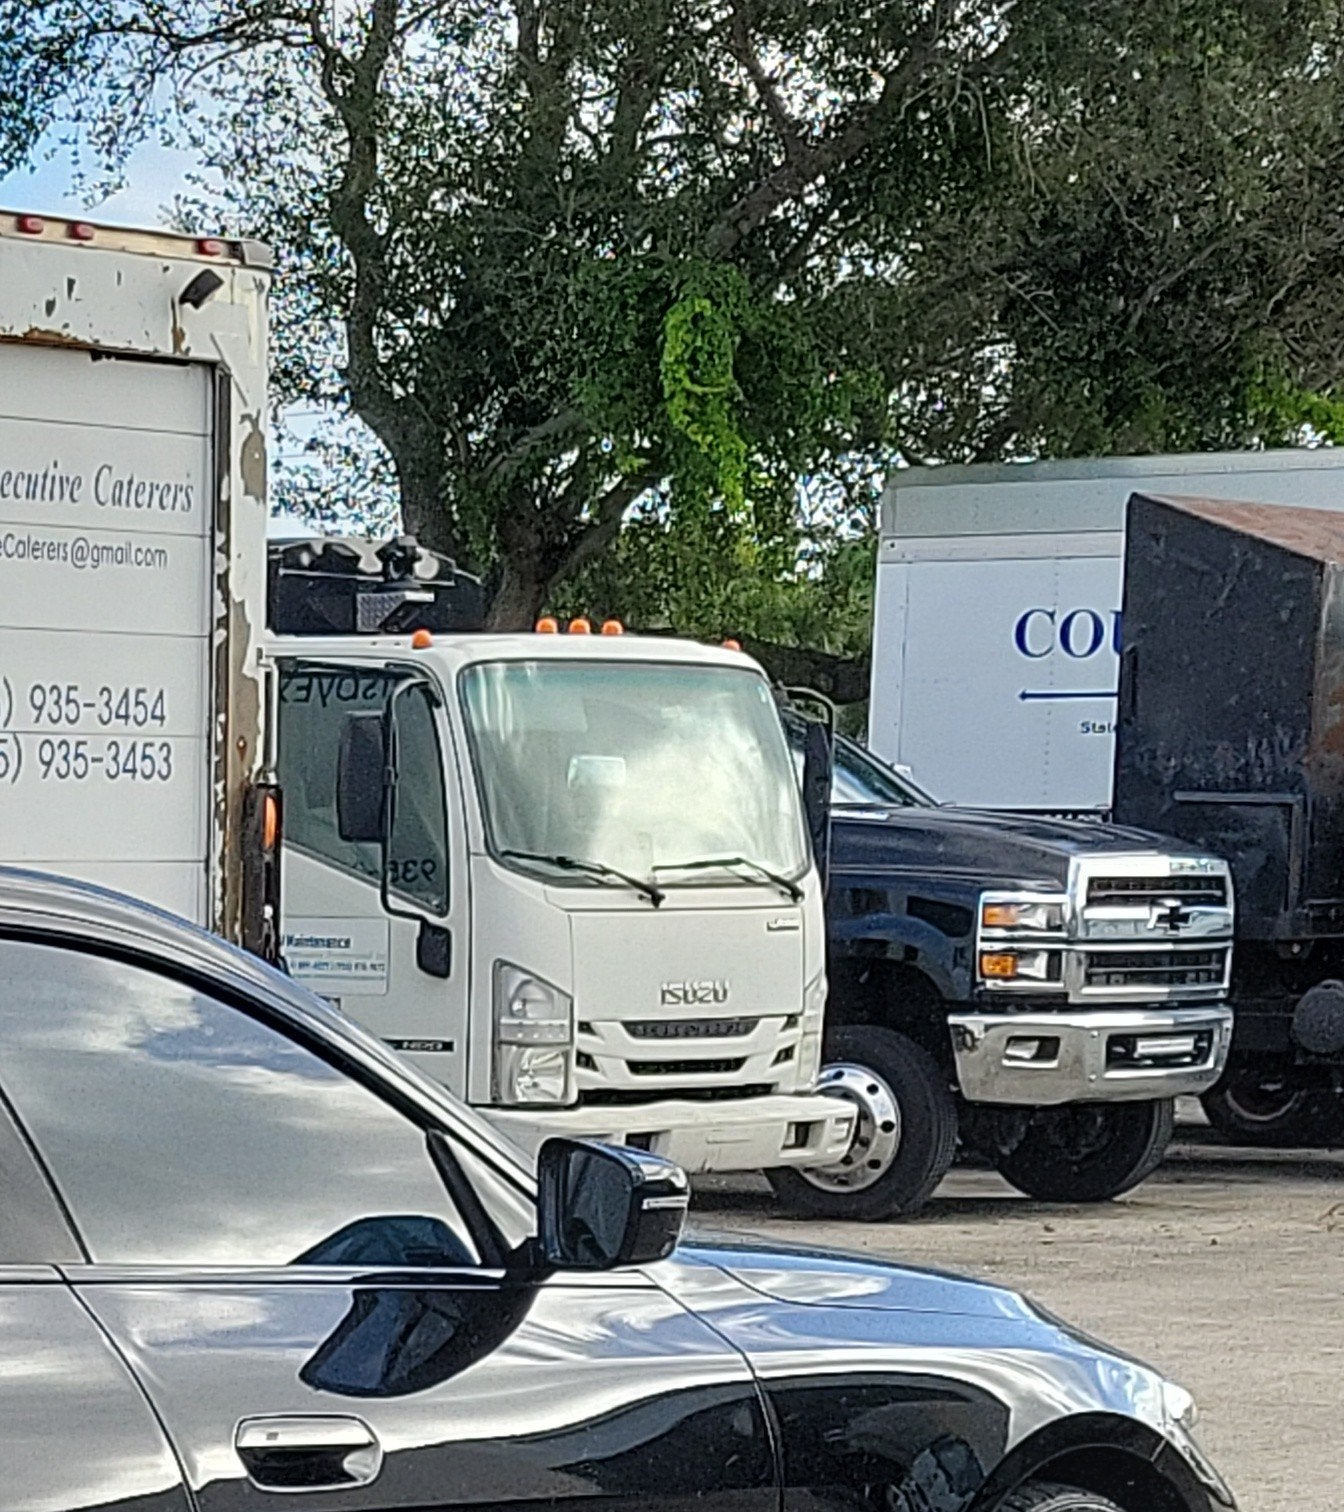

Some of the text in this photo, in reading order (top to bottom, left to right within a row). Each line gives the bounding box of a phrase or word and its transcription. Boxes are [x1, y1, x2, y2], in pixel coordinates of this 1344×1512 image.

[94, 463, 194, 513] Caterers
[29, 684, 167, 727] 935-3454
[39, 738, 173, 781] 935-3453
[661, 979, 730, 1006] ISUZU
